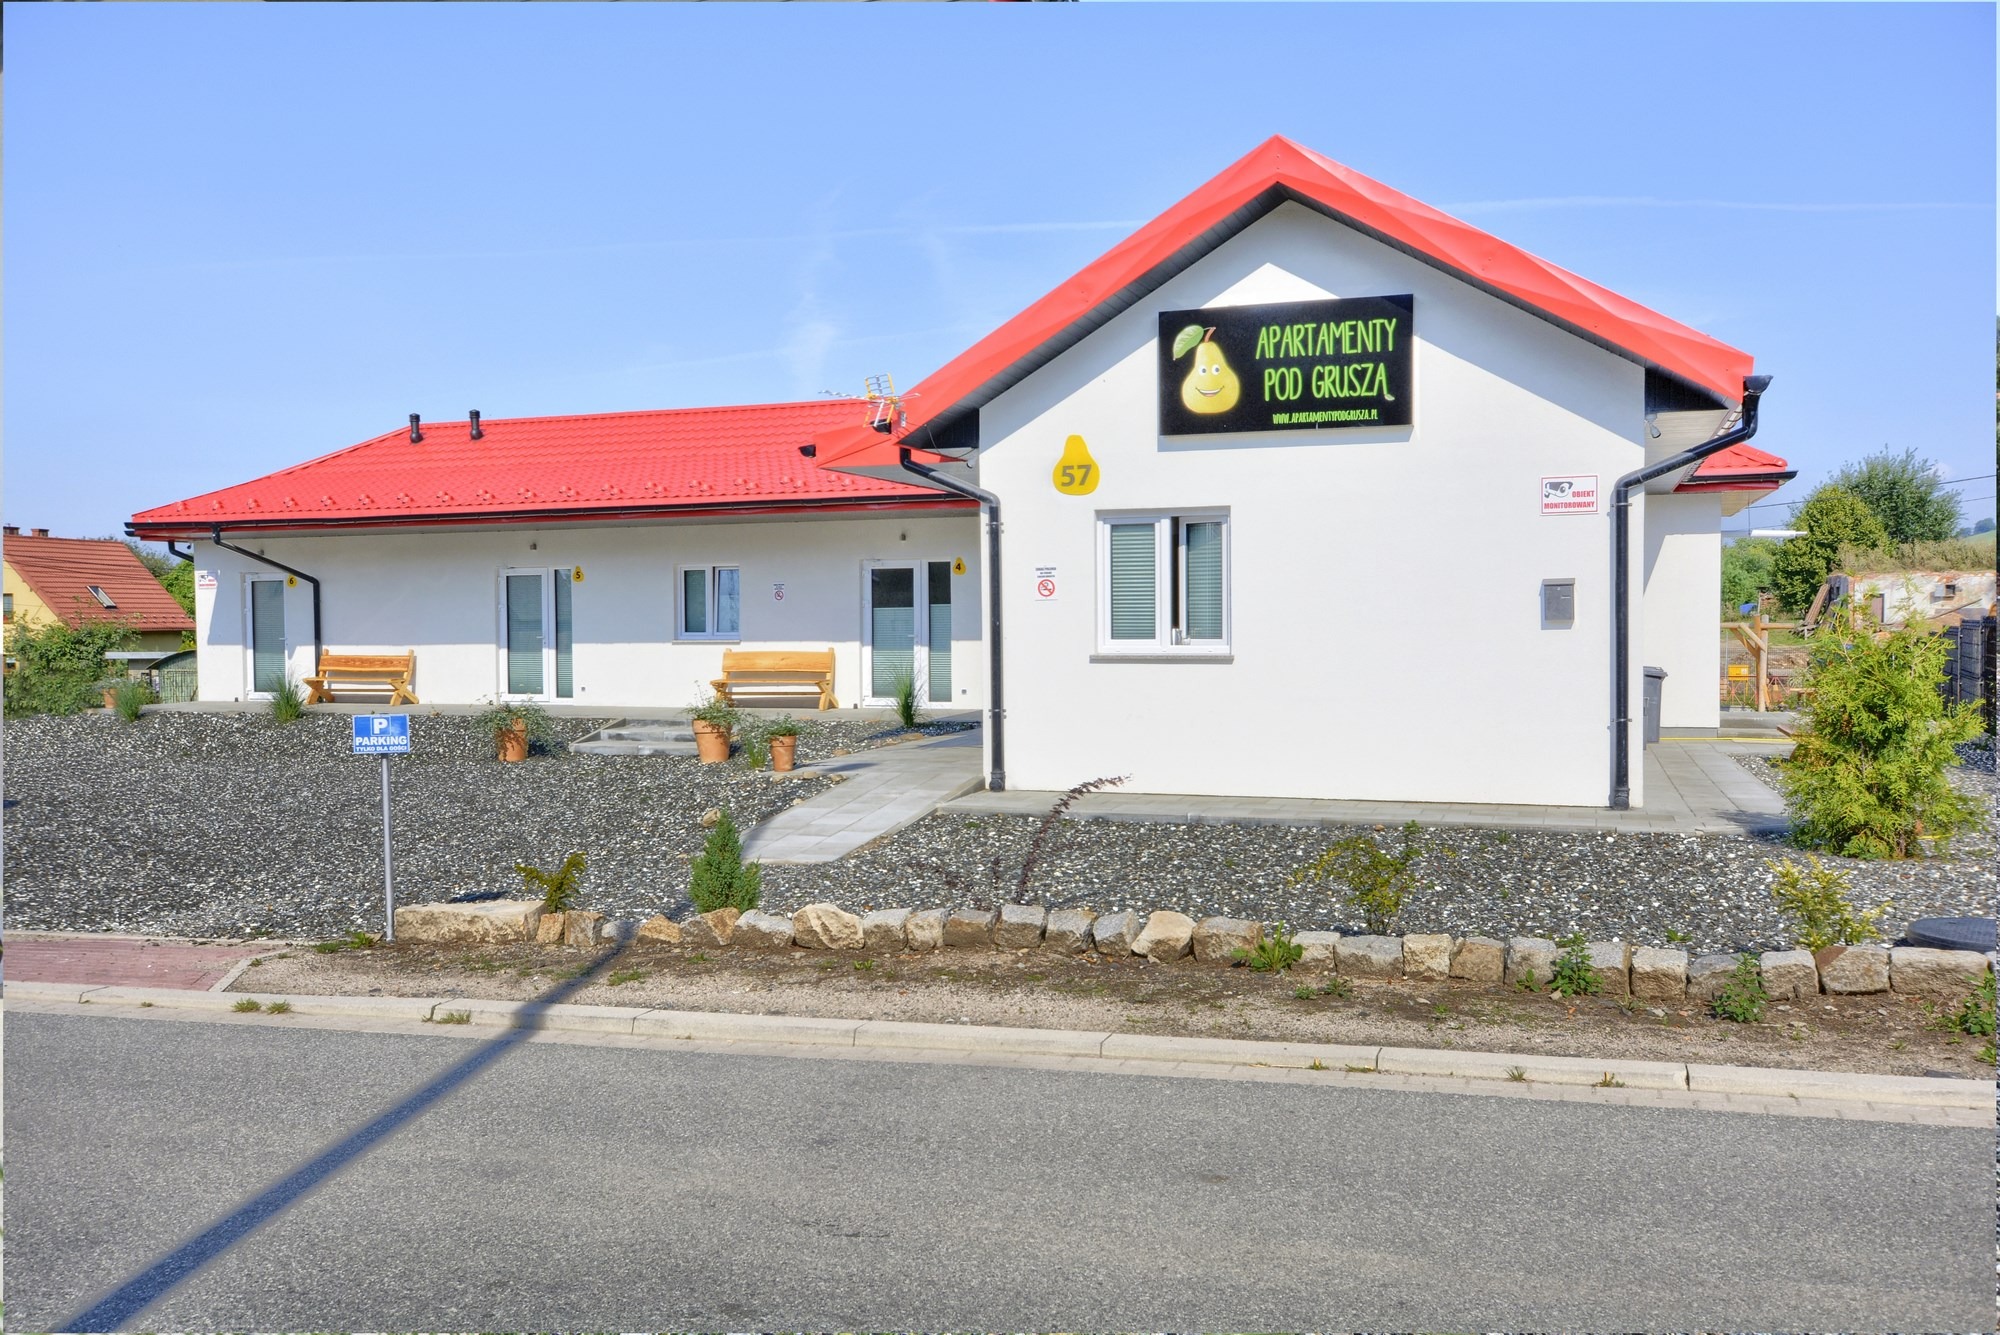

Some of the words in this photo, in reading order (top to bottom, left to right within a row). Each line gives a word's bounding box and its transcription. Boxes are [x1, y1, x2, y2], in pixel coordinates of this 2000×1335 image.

[1255, 317, 1397, 359] APARTAMENTY
[1264, 366, 1303, 401] POD
[1061, 464, 1092, 487] 57
[1572, 490, 1595, 498] OBIEKT
[1544, 501, 1595, 509] MONITOROWANY
[955, 562, 961, 571] 4
[575, 571, 581, 579] 5
[289, 576, 294, 585] 6
[373, 718, 388, 734] P
[355, 736, 407, 746] PARKING
